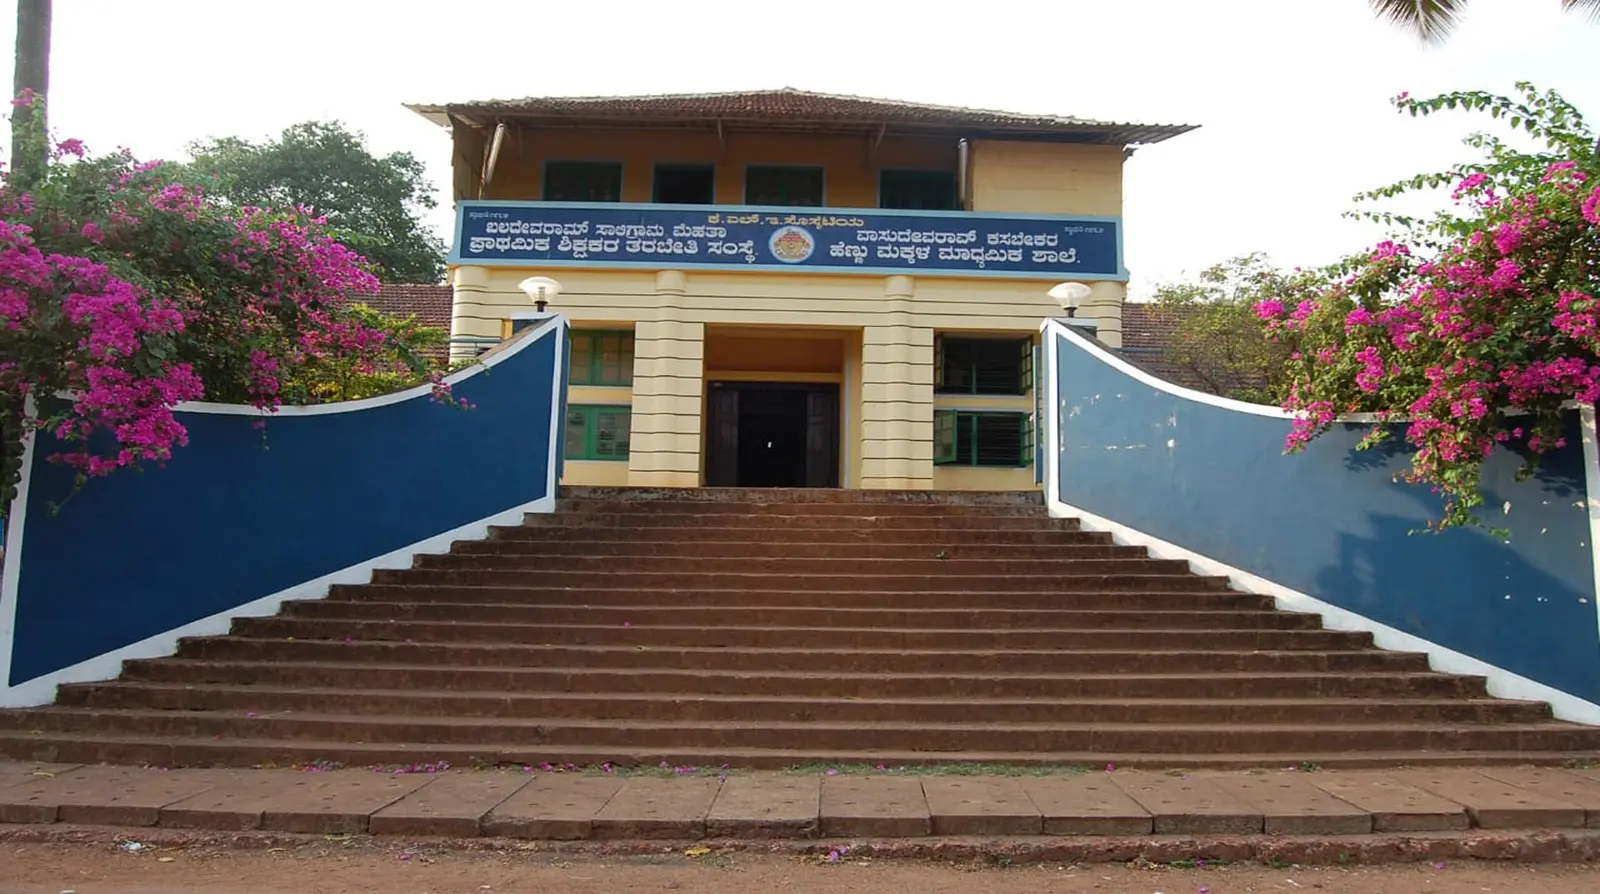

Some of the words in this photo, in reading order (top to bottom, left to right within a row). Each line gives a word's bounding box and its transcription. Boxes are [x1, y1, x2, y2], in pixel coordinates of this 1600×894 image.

[673, 223, 728, 238] ಮೆಹತಾ
[987, 231, 1059, 247] ಕಸಬೇಕರ
[469, 235, 550, 253] ಪ್ರಾಥಮಿಕ
[557, 235, 620, 259] ಶಿಕ್ಷಕರ
[626, 237, 699, 255] ತರಬೇತಿ
[829, 241, 868, 264] ಹೆಣ್ಣು
[877, 243, 931, 265] ಮಕ್ಕಳ
[938, 246, 1023, 269] ಮಾಧ್ಯಮಿಕ
